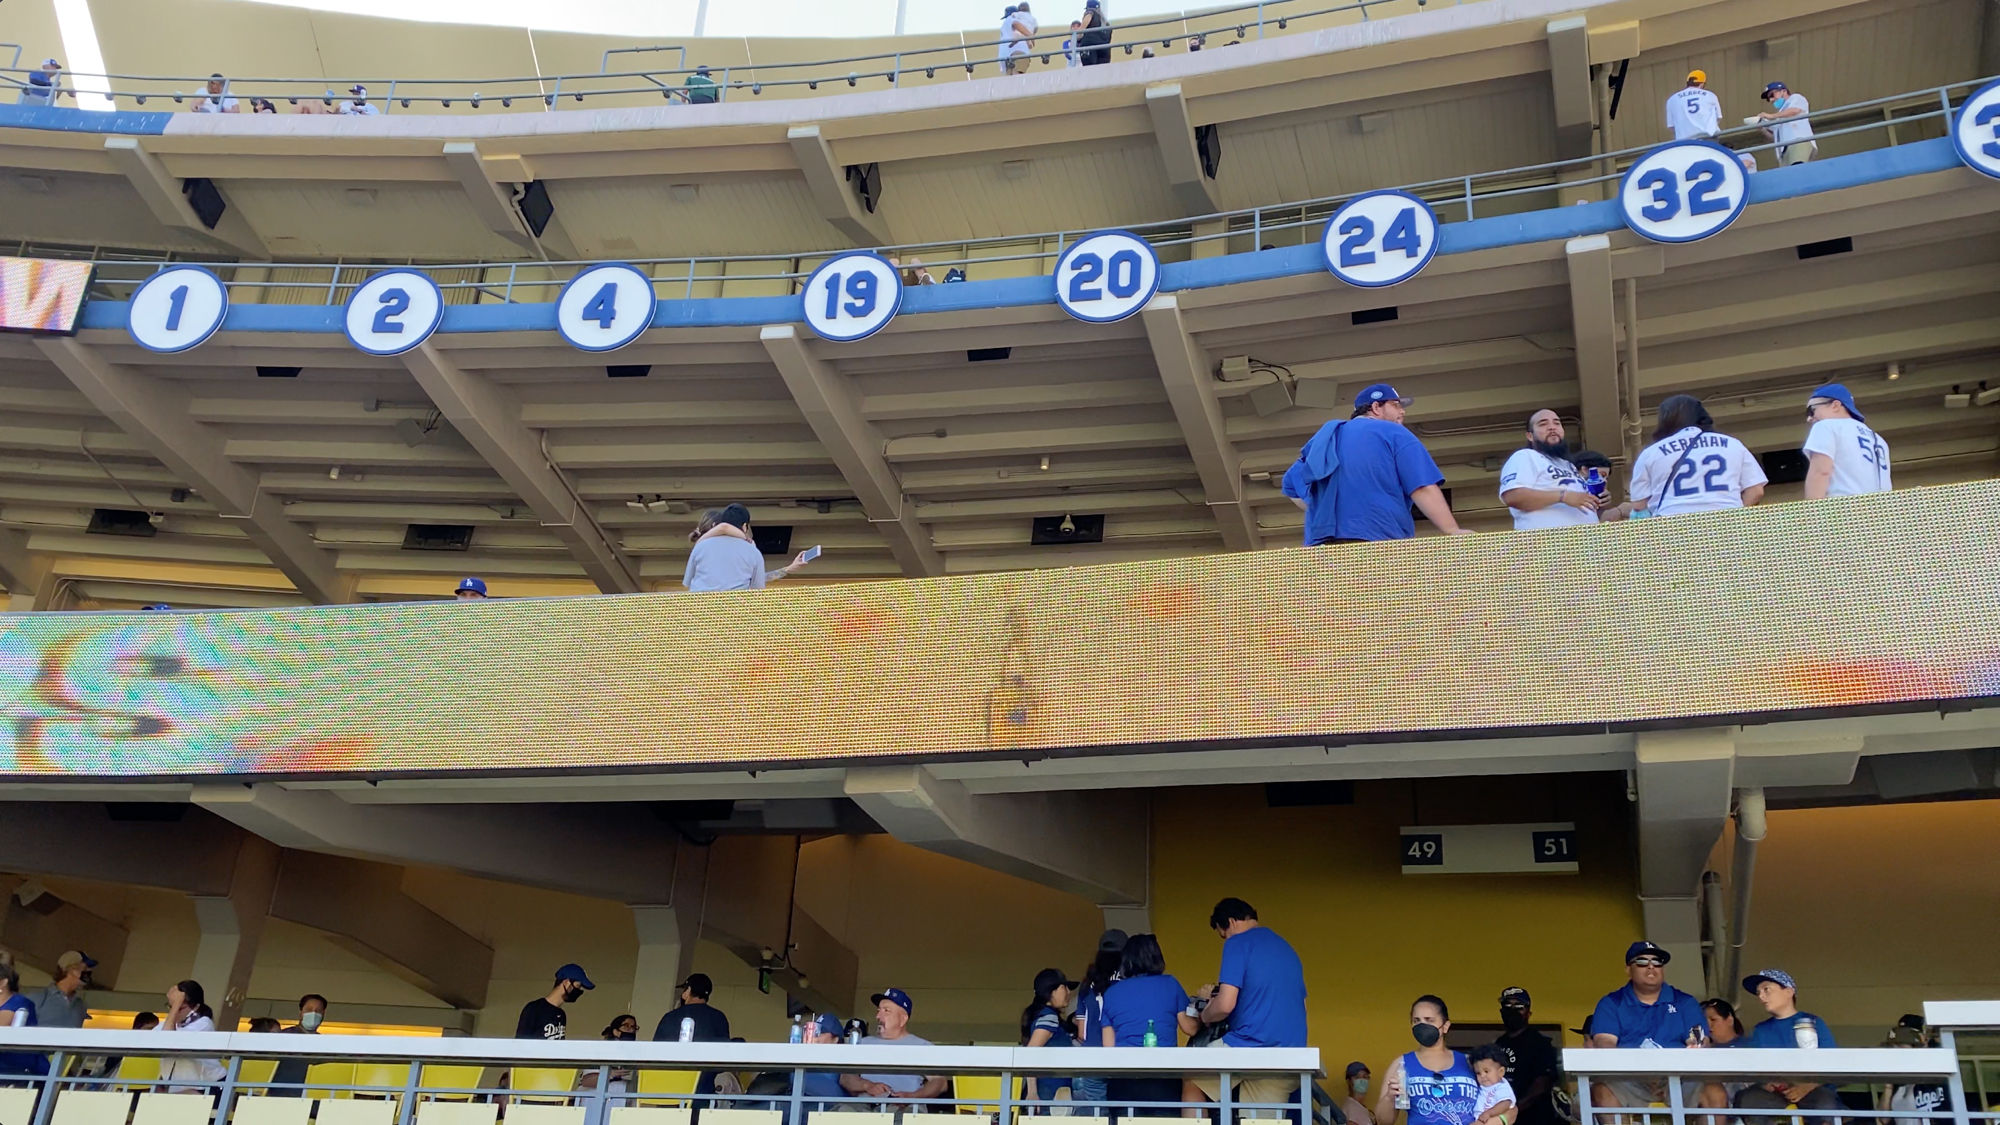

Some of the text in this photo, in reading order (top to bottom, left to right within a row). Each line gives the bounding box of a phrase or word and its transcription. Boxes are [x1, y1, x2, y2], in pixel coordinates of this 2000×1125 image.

[1686, 97, 1700, 114] 5
[1637, 159, 1731, 223] 32
[1338, 207, 1421, 268] 24
[825, 270, 878, 319] 19
[1068, 249, 1142, 302] 20
[165, 285, 189, 331] 1
[371, 288, 411, 333] 2
[581, 282, 618, 329] 4
[1673, 454, 1729, 497] 22
[1407, 841, 1436, 858] 49
[1544, 838, 1568, 856] 51
[1408, 1084, 1432, 1097] OUT
[1458, 1084, 1479, 1099] THE
